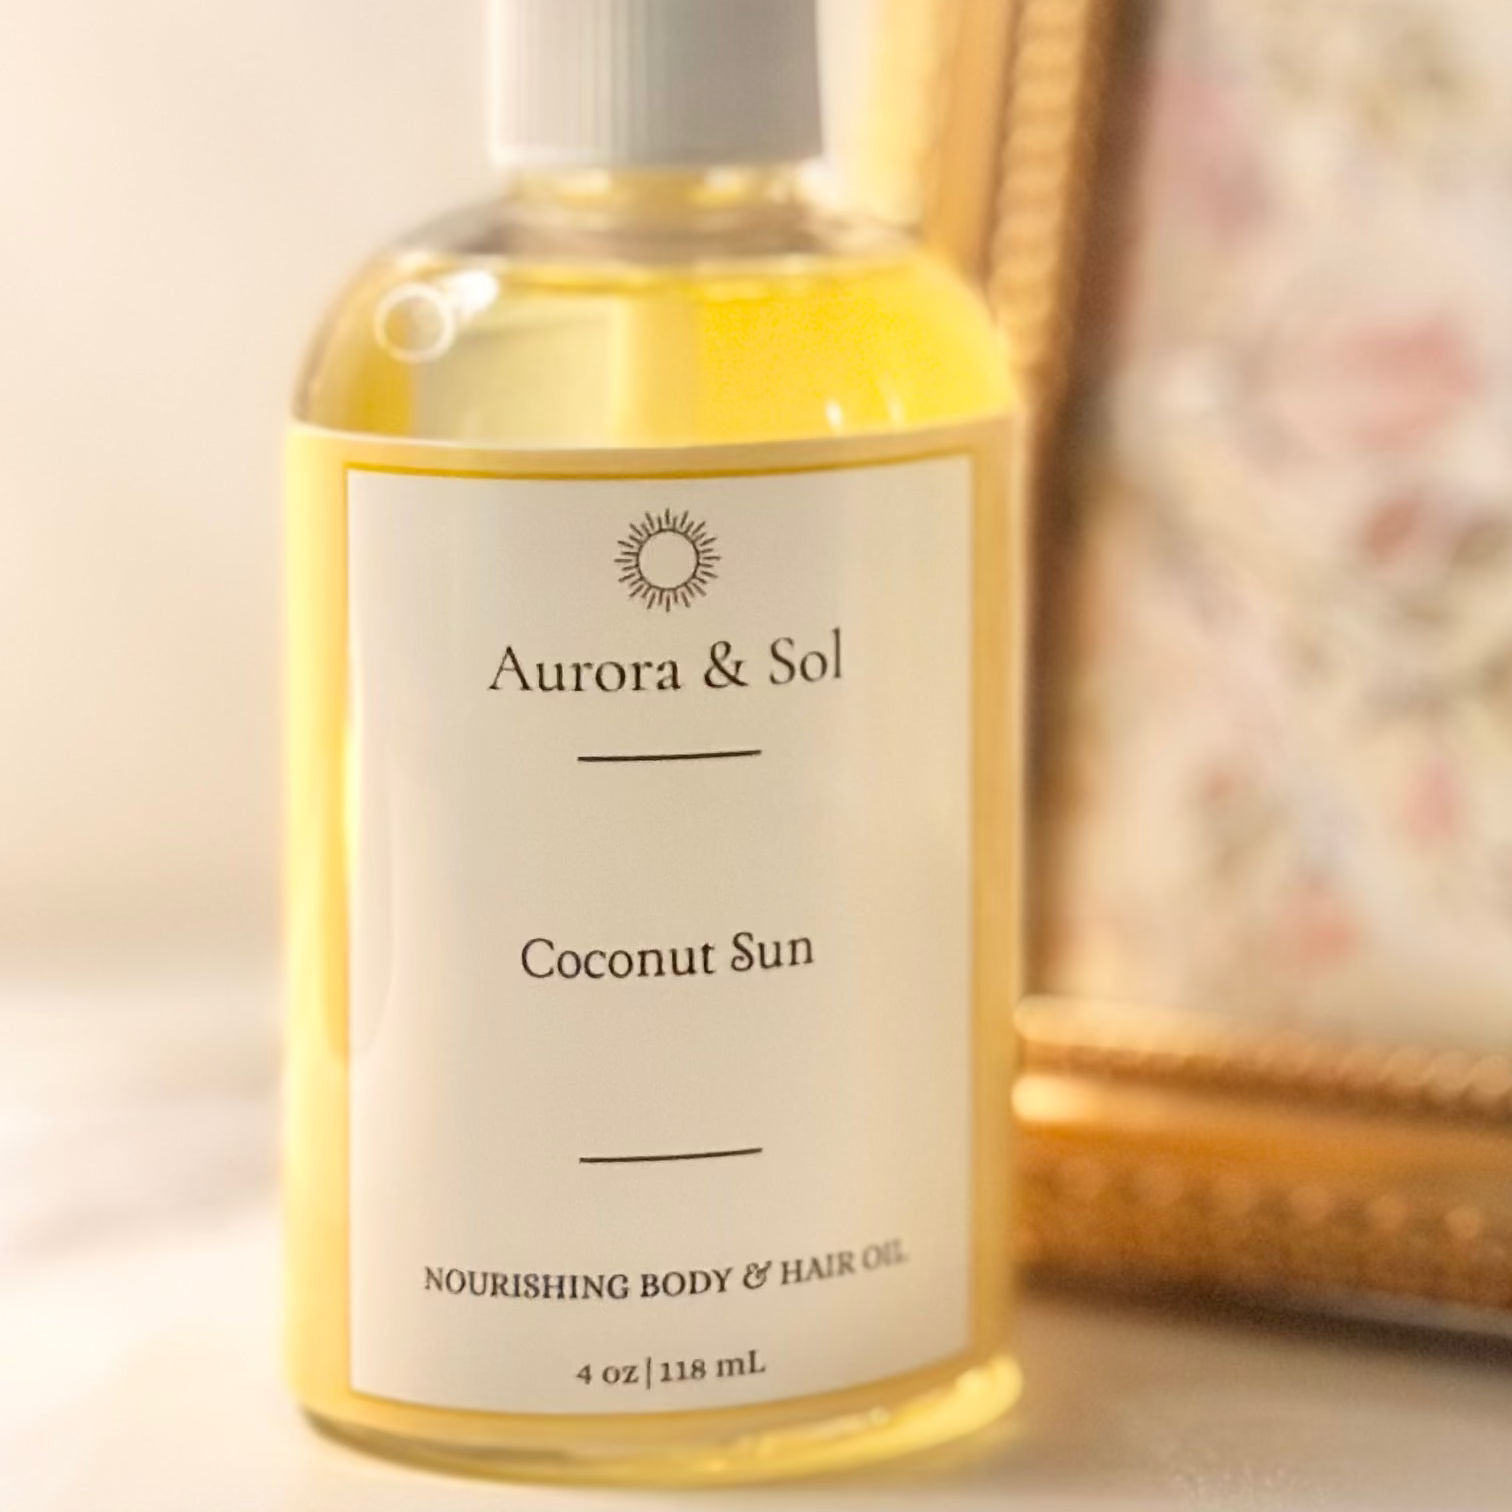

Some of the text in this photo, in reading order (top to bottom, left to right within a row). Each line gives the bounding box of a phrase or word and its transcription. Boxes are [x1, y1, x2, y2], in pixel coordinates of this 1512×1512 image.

[487, 626, 843, 693] Aurora & Sol
[520, 931, 815, 981] Coconut Sun
[424, 1238, 907, 1301] NOURISHING BODY & HAIR OIL
[575, 1363, 594, 1386] 4
[716, 1349, 767, 1379] mL
